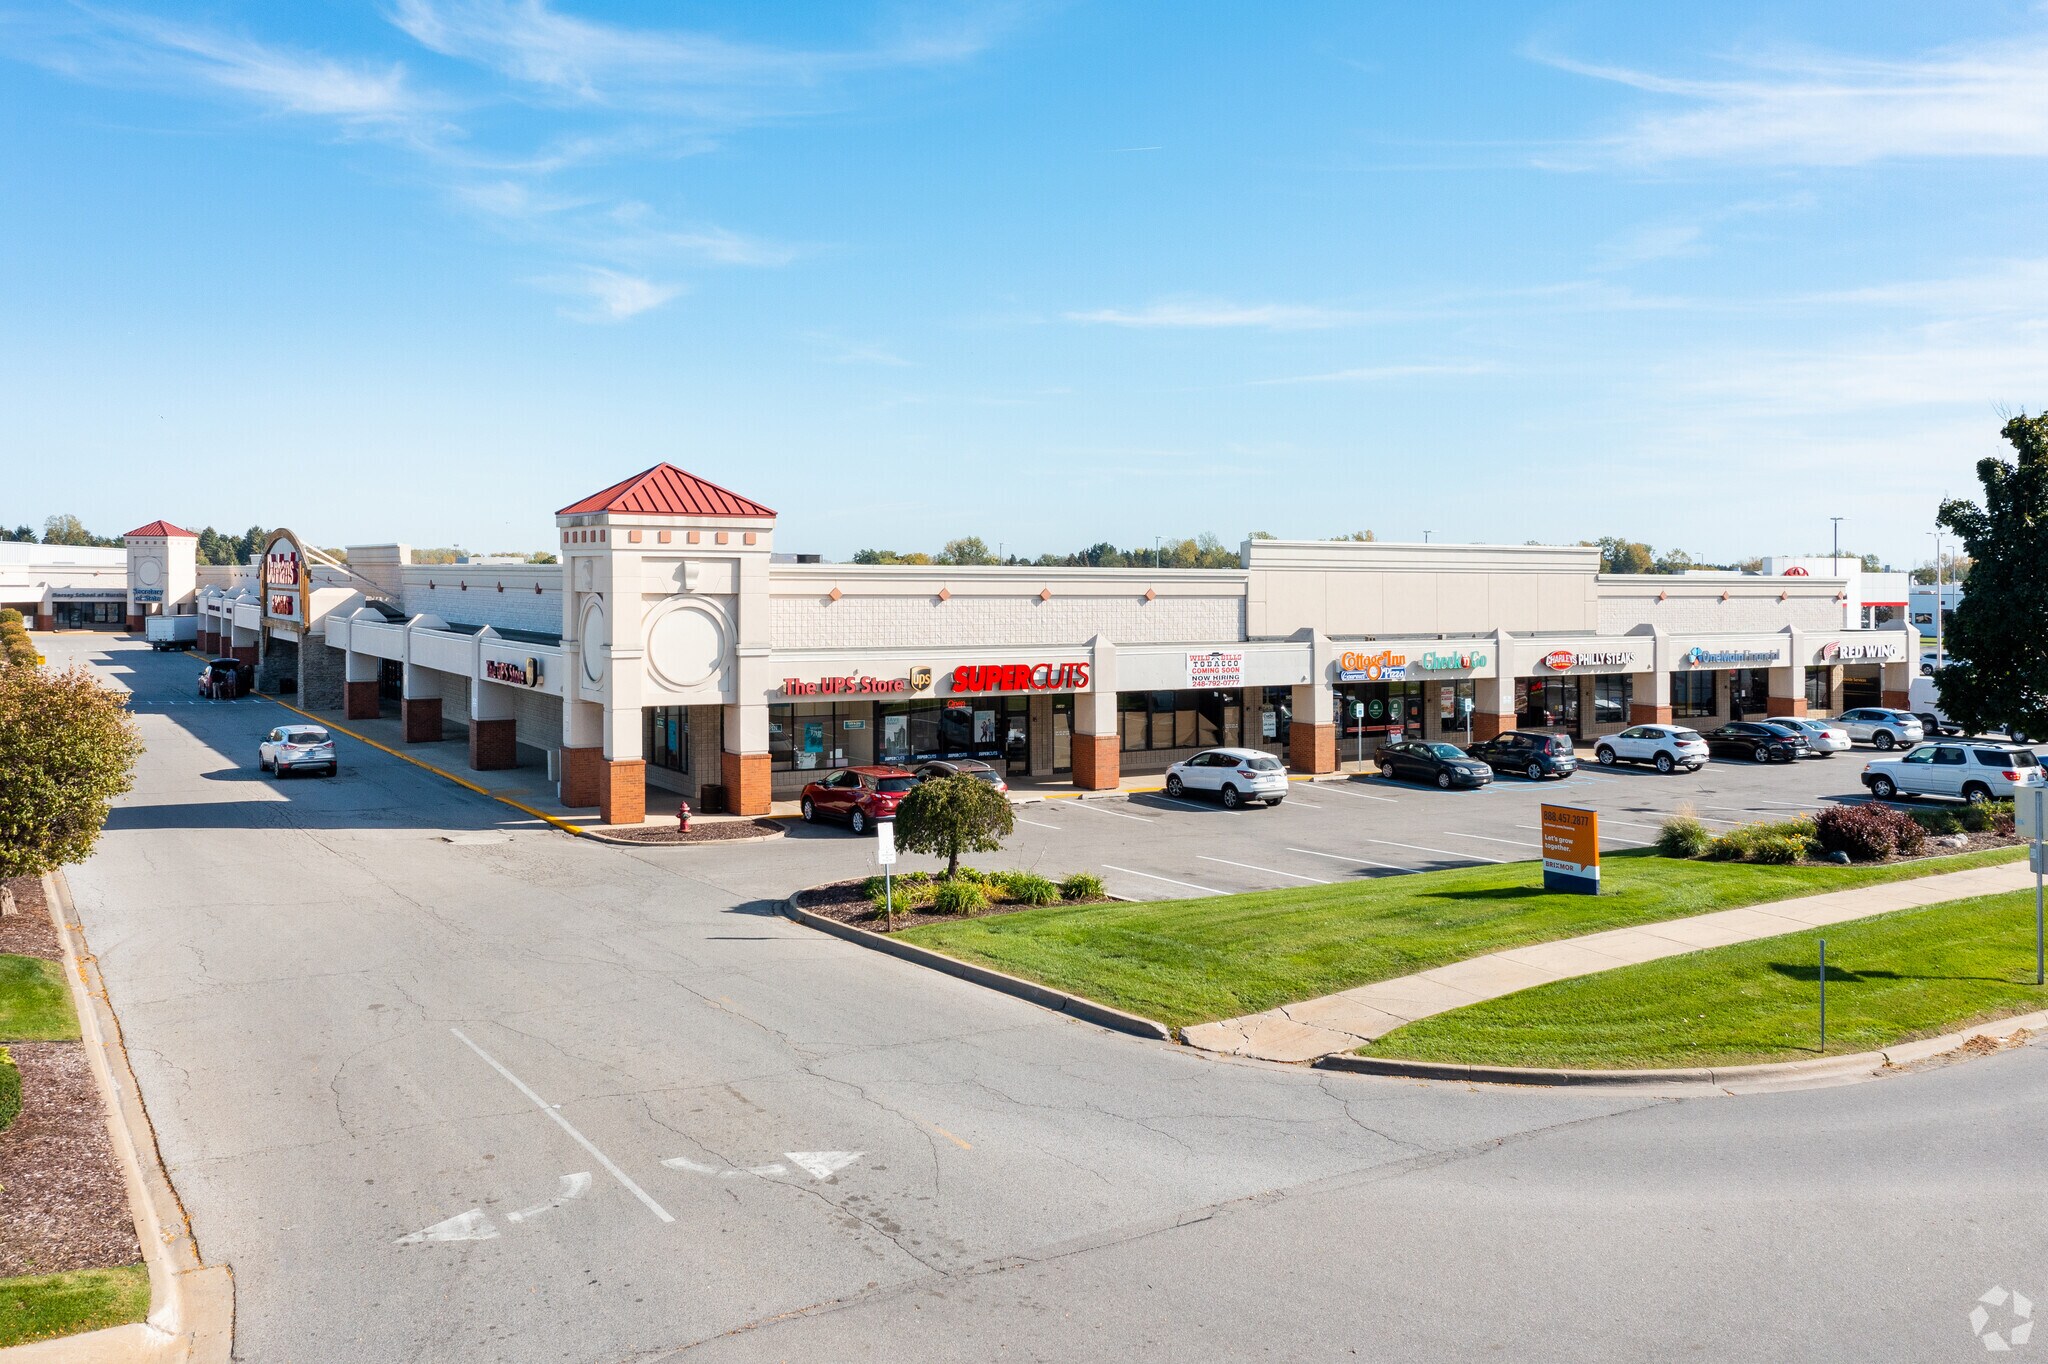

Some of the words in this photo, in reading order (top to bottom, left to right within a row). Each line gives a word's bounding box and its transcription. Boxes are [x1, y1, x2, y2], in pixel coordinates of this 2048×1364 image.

[133, 588, 164, 596] Secretary
[1702, 649, 1745, 663] OneMain
[1744, 649, 1780, 661] Financial
[1838, 644, 1864, 659] RED
[1863, 643, 1897, 658] WING
[1341, 651, 1385, 671] Cottage
[1383, 650, 1406, 667] Inn
[1423, 651, 1462, 670] Check
[1470, 651, 1487, 668] Go
[1546, 654, 1577, 667] CHARLEYS
[1577, 652, 1606, 666] PHILLY
[1605, 652, 1636, 665] STEAKS
[952, 662, 1090, 693] SUPERCUTS
[1384, 668, 1405, 679] Pizza
[783, 678, 817, 696] The
[820, 677, 856, 695] UPS
[860, 676, 905, 694] Store
[913, 674, 930, 689] ups
[947, 700, 966, 709] Open
[1543, 811, 1589, 826] 888.457.2877
[1544, 834, 1558, 842] Let's
[1558, 837, 1574, 845] grow
[1544, 843, 1571, 852] together.
[1545, 861, 1574, 871] BRIXMOR
